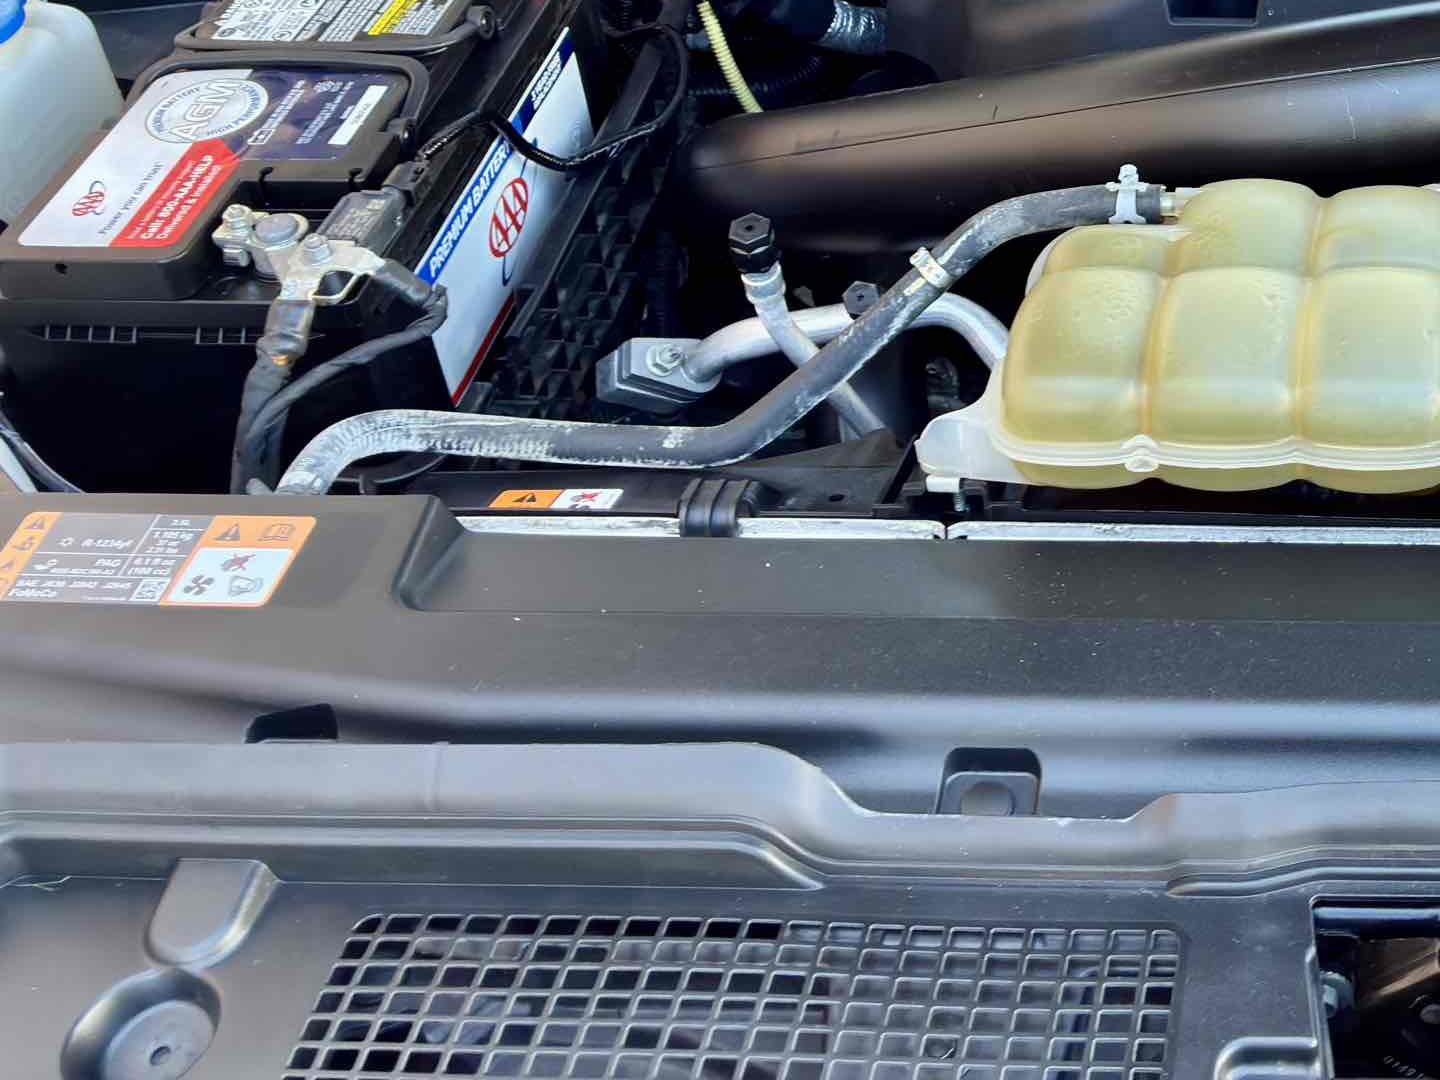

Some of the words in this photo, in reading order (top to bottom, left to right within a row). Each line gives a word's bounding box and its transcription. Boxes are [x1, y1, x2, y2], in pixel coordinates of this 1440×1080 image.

[169, 81, 241, 139] AGM
[428, 195, 475, 277] PREMIUM
[489, 176, 529, 258] AAA
[94, 559, 122, 568] PAG
